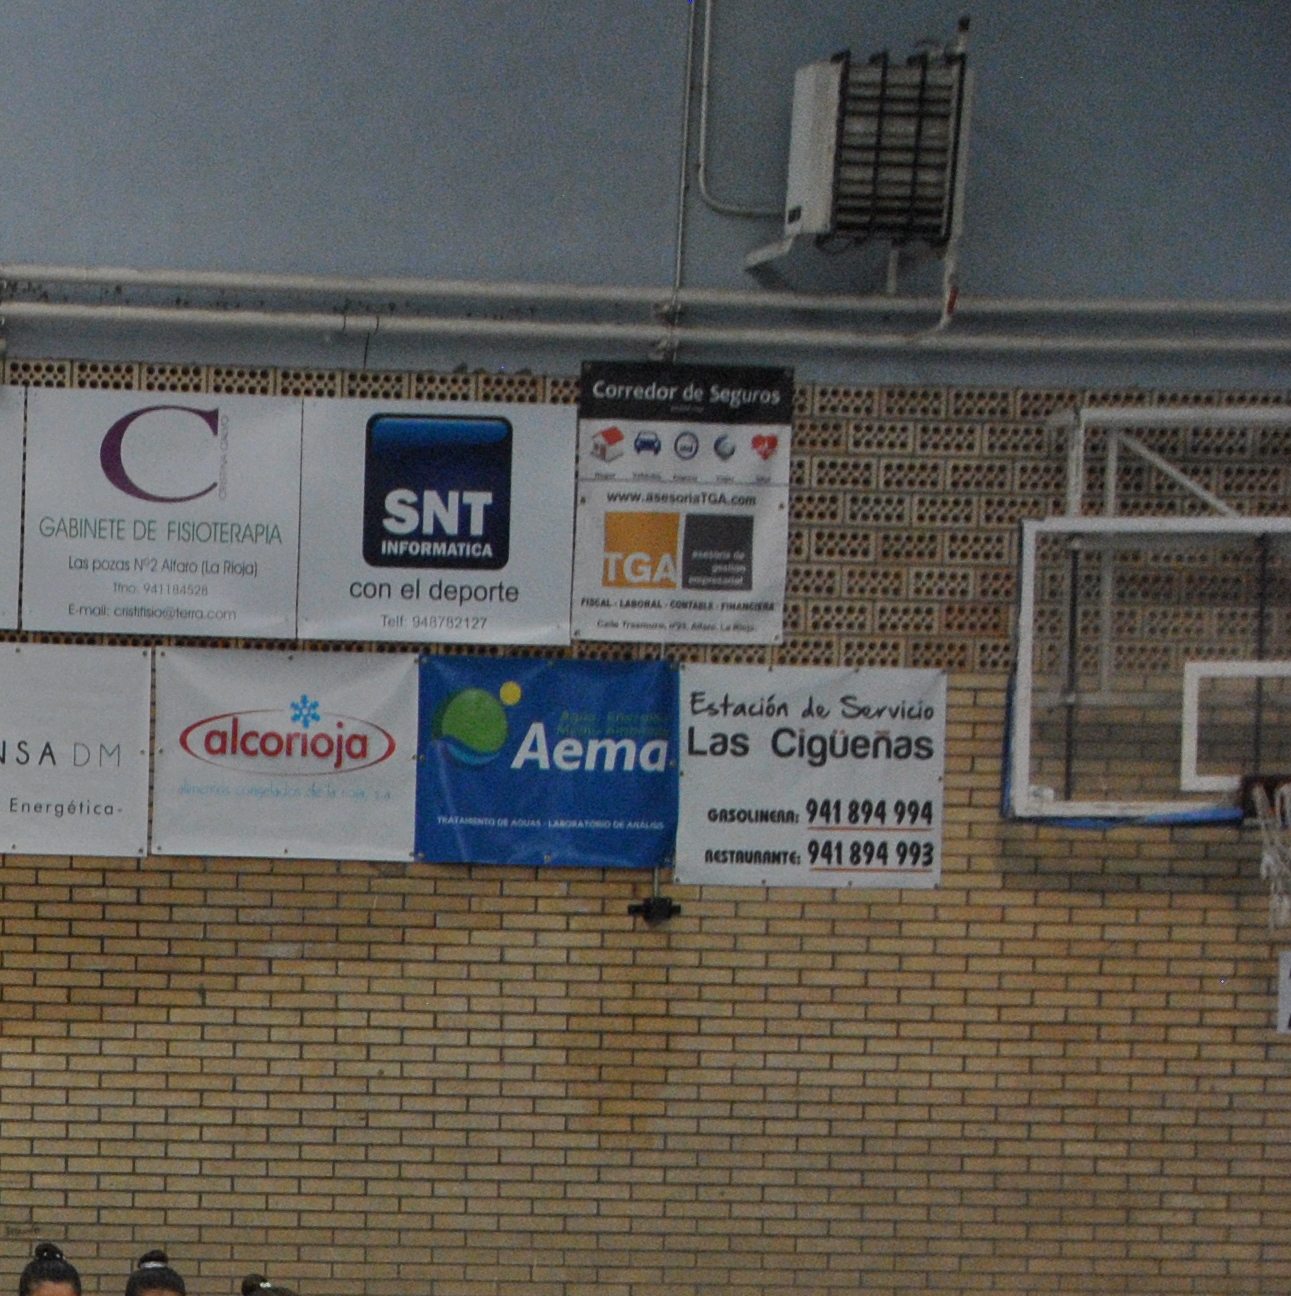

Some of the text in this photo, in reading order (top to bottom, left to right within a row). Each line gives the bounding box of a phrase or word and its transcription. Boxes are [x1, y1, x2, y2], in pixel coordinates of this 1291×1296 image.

[593, 380, 780, 408] Corredor de Seguros
[100, 404, 219, 503] C
[383, 489, 493, 536] SNT
[39, 516, 282, 545] GABINETE DE FISIOTERAPIA
[381, 540, 492, 558] INFORMATICA
[69, 556, 88, 570] Las
[92, 558, 130, 572] pozas
[161, 559, 198, 574] Alfaro
[201, 560, 219, 575] (La
[223, 560, 258, 578] Rioja)
[605, 552, 677, 583] TGA
[143, 583, 208, 596] 941184528
[350, 580, 519, 606] con el deporte
[69, 603, 110, 616] E-mail:
[580, 597, 774, 612] FISCAL LABORAL CONTABLE FINANCIERA
[412, 616, 487, 629] 948782127
[691, 692, 934, 720] Estación de Servicio
[73, 742, 121, 768] DM
[204, 716, 368, 769] alcorioja
[510, 721, 668, 772] Aema
[688, 726, 934, 767] Las Cigüeñas
[437, 816, 494, 826] TRATAMIENTO
[497, 818, 508, 826] DE
[511, 818, 541, 827] AGUAS
[548, 819, 611, 829] LABORATORIO
[613, 820, 624, 829] DE
[708, 798, 933, 826] GASOLINERA: 941 894 994
[705, 840, 934, 867] RESTAURANTE: 941 894 993
